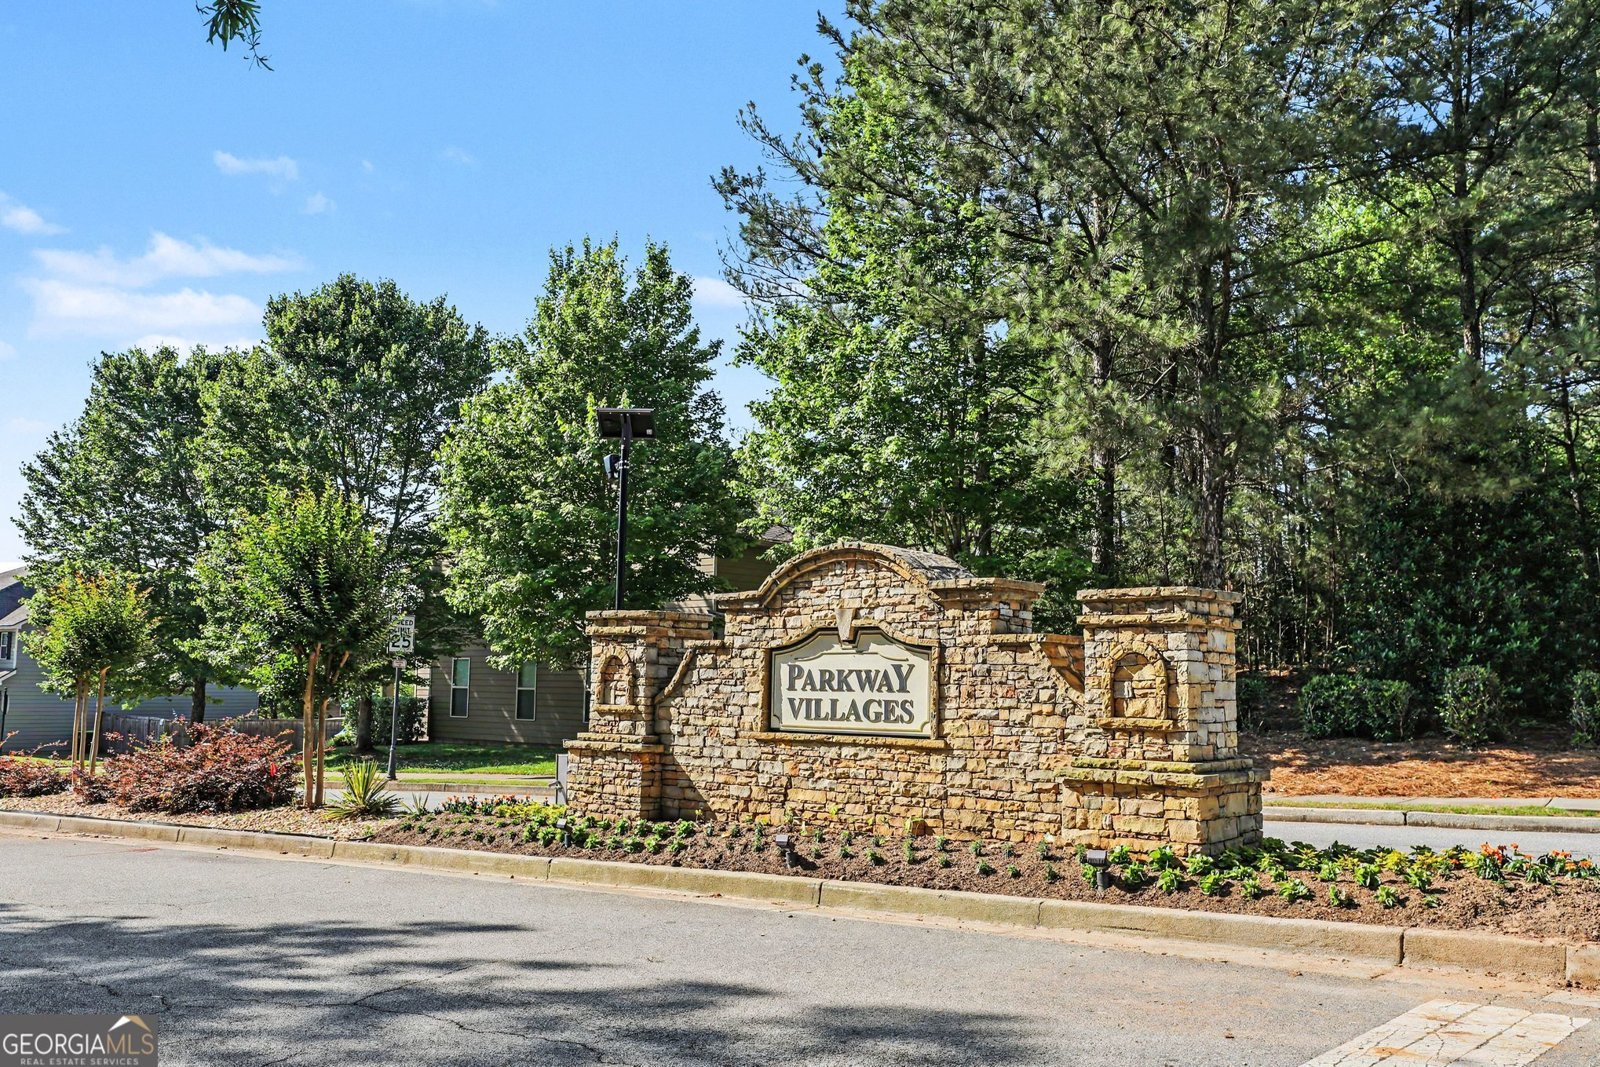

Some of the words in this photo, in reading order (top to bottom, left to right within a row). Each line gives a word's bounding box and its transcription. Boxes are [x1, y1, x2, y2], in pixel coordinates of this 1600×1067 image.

[391, 635, 411, 648] 25
[786, 663, 916, 693] PARKWAY
[787, 697, 915, 725] VILLAGES
